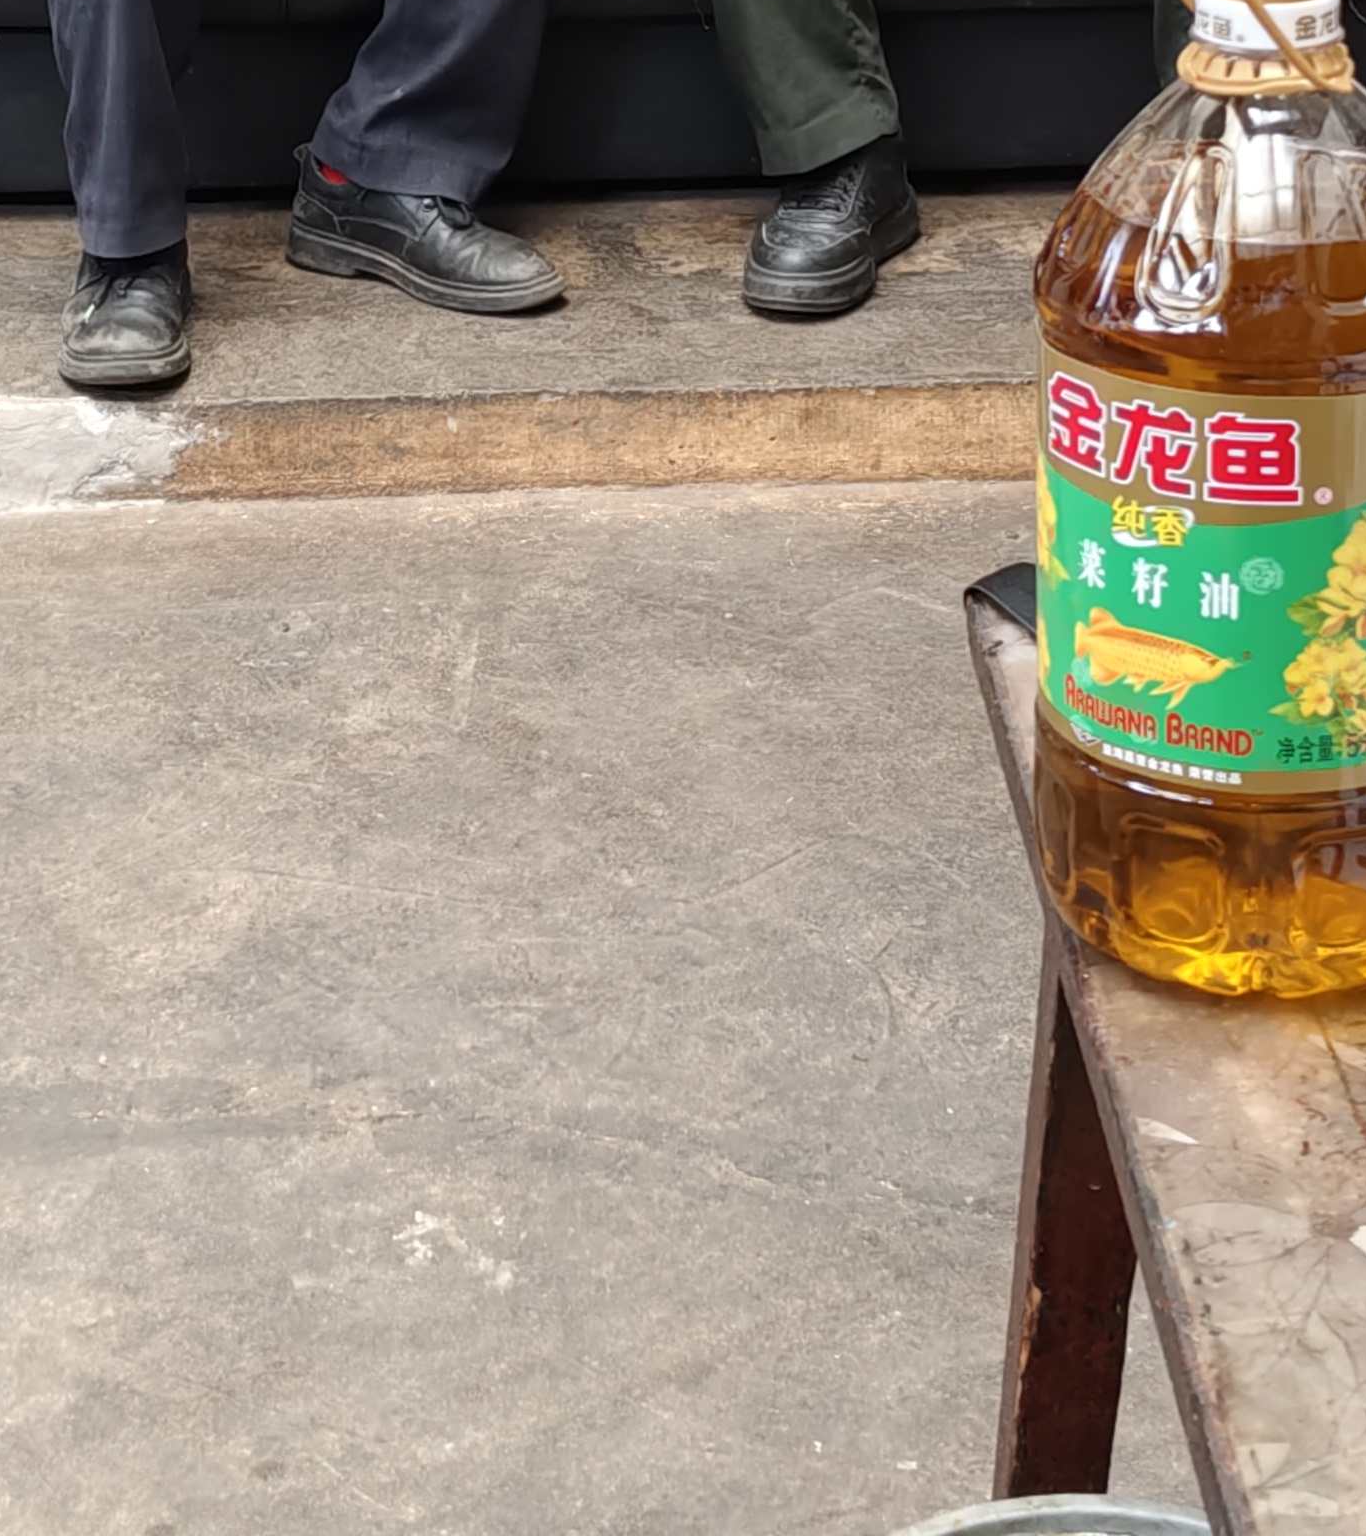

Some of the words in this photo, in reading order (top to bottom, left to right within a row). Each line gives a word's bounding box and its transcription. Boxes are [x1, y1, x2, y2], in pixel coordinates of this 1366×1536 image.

[1048, 371, 1303, 506] 金龙鱼
[1112, 495, 1189, 548] 纯香
[1078, 538, 1239, 621] 菜籽油
[1064, 674, 1156, 741] ARAWANA
[1166, 712, 1253, 757] BRAND
